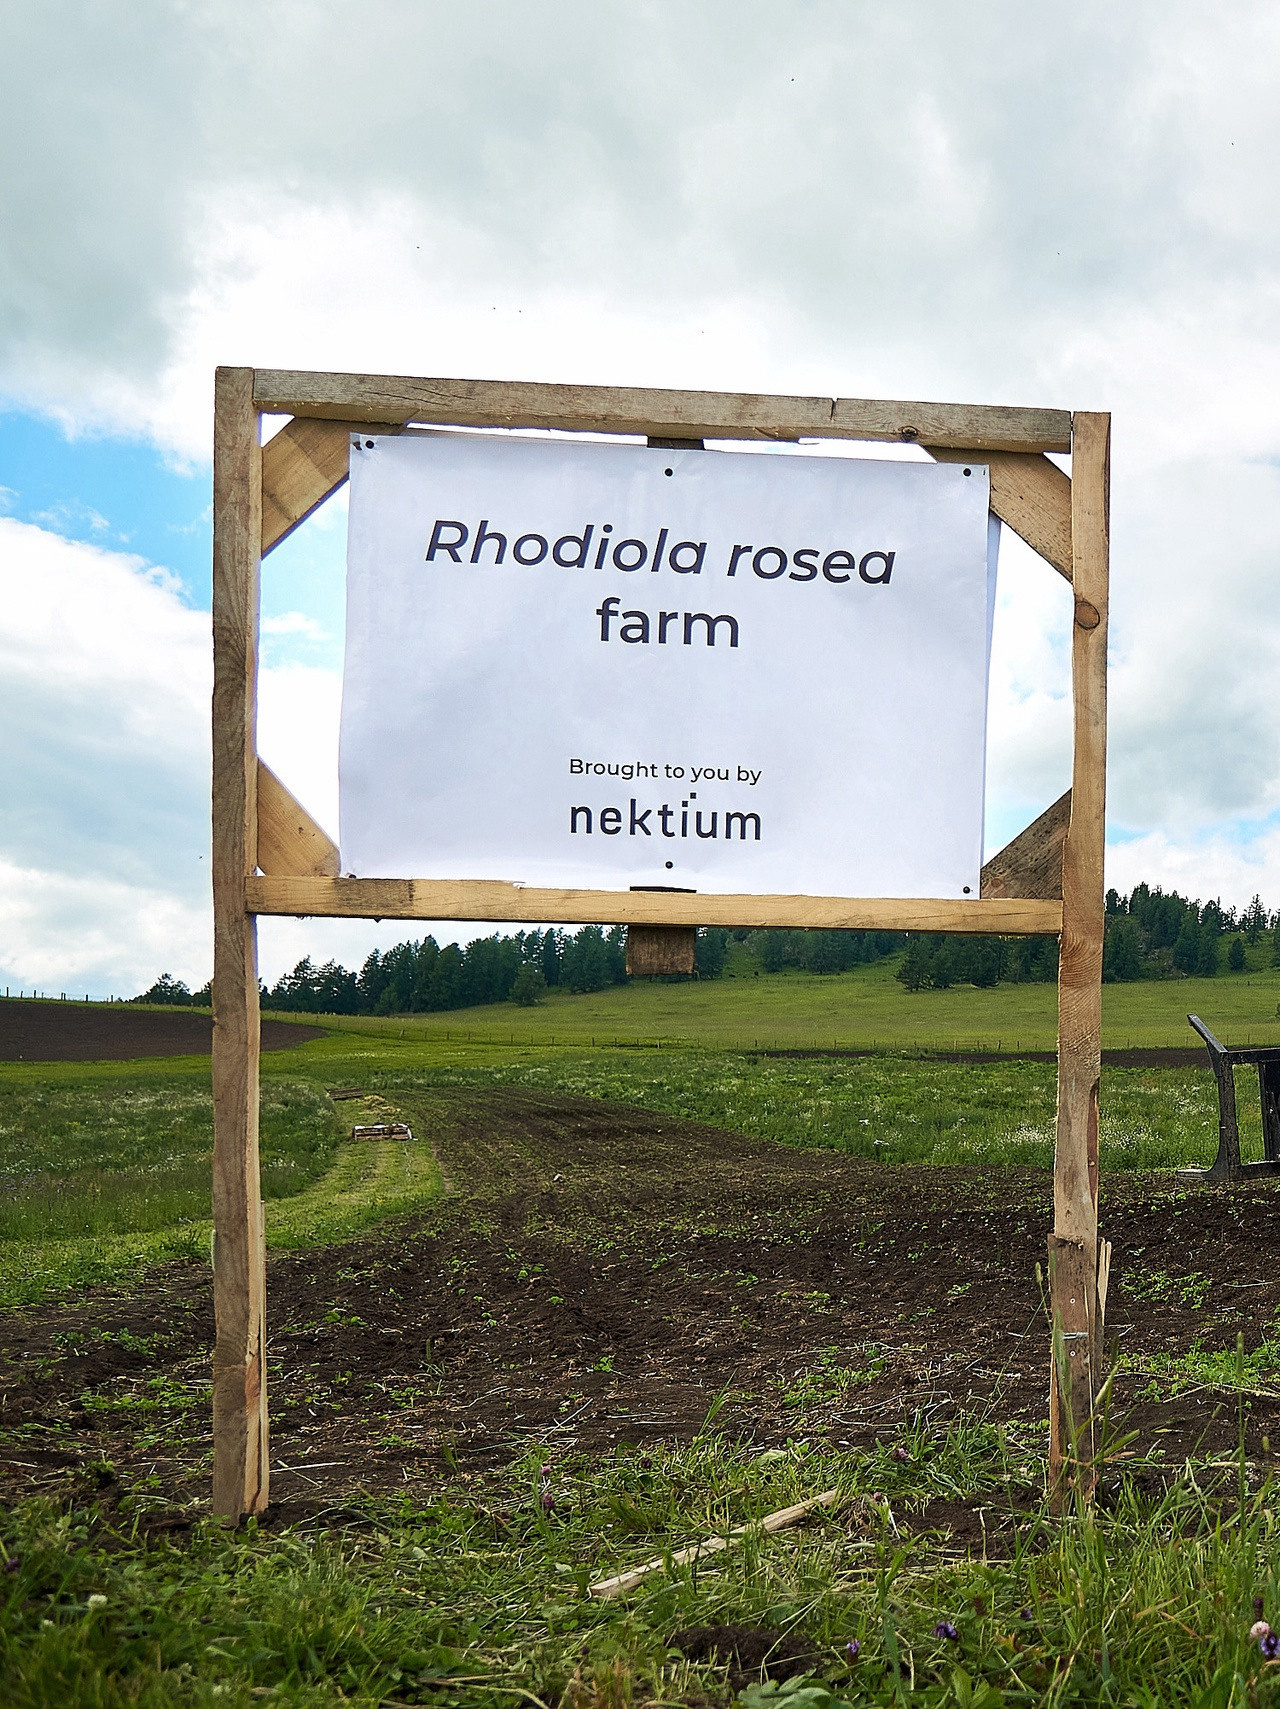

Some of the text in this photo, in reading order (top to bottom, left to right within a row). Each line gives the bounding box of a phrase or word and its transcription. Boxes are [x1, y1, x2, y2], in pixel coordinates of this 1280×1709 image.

[425, 519, 896, 585] Rhodiola rosea
[595, 596, 739, 648] farm
[569, 758, 763, 786] Brought to you by
[570, 792, 761, 841] nektium
